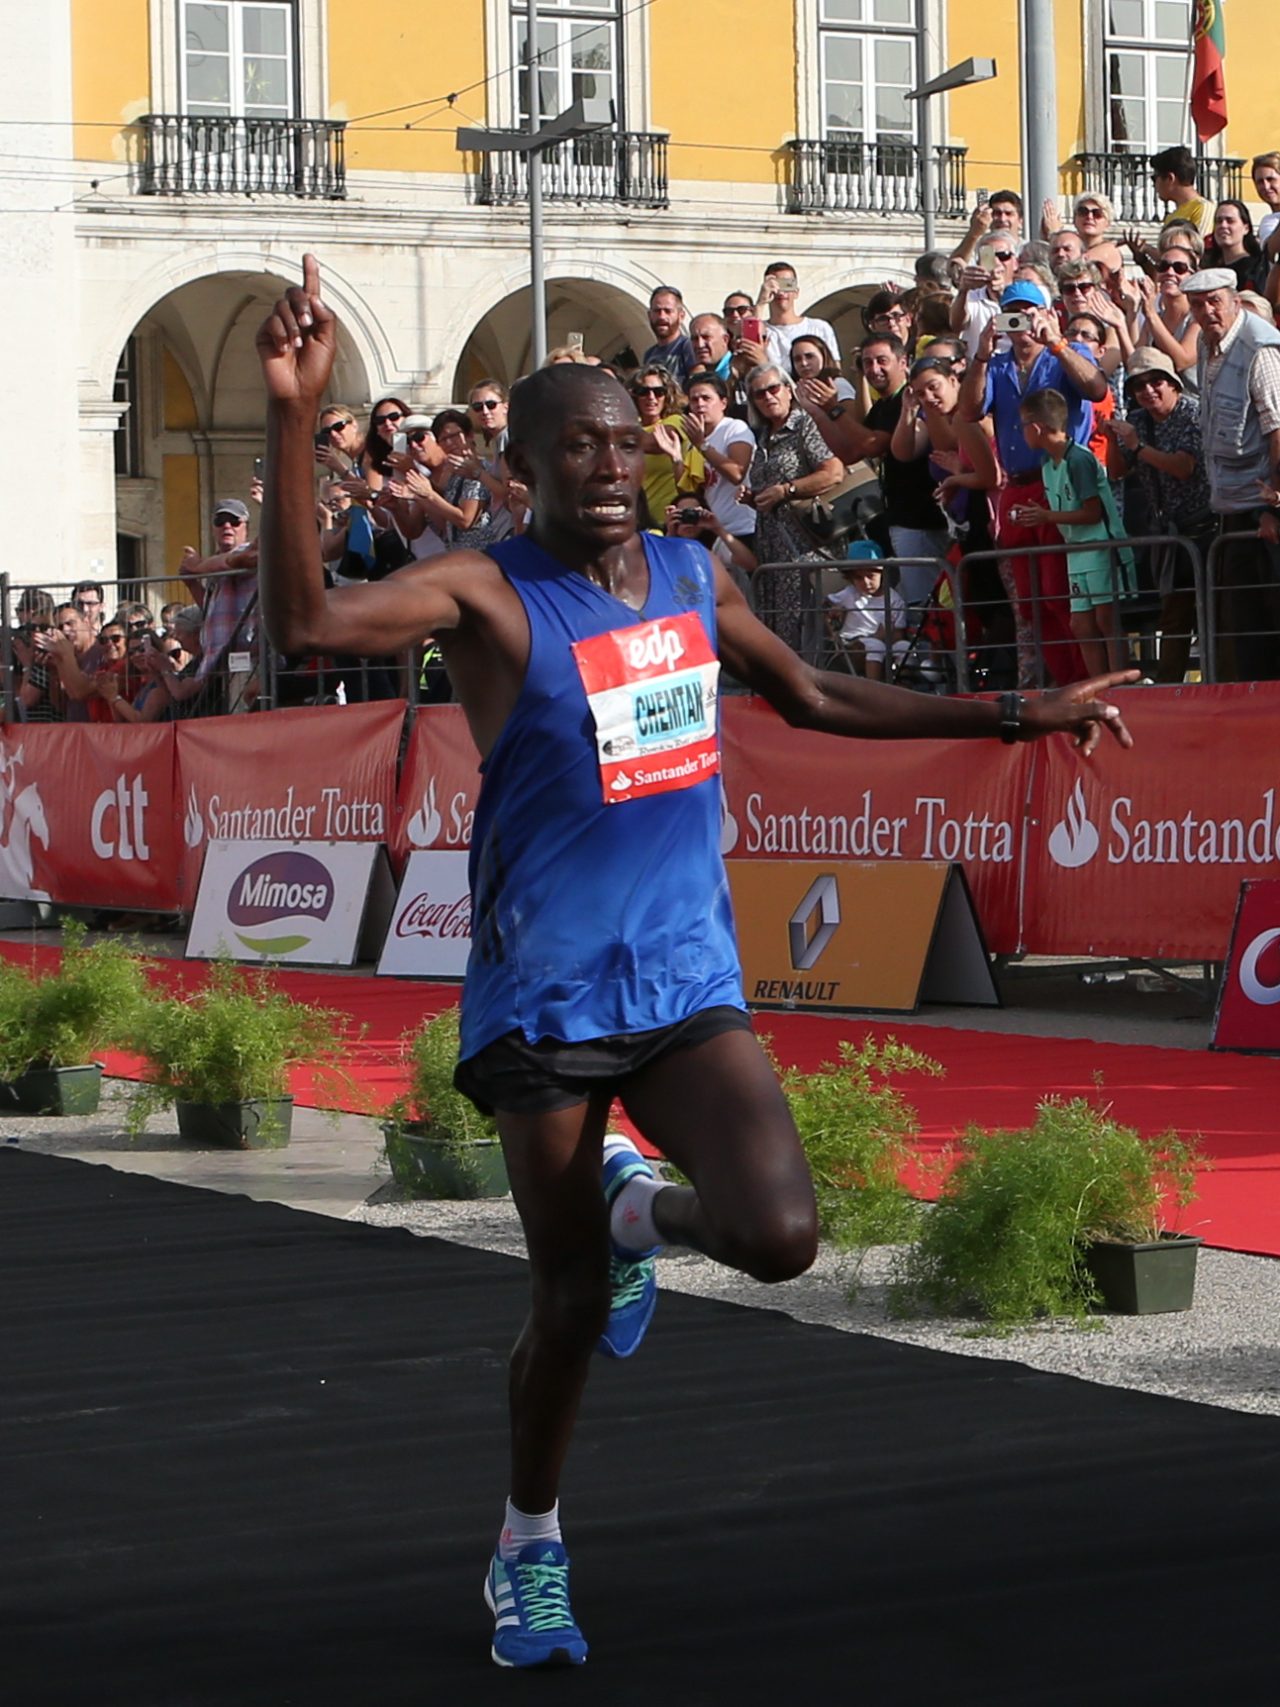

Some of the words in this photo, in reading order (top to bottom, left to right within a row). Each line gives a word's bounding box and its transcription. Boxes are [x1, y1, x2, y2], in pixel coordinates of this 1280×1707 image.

[629, 624, 685, 671] edp
[634, 757, 699, 787] Santander
[91, 774, 148, 860] ctt
[207, 786, 316, 840] Santander
[321, 788, 384, 837] Totta
[747, 790, 907, 857] Santander
[915, 797, 1013, 862] Totta
[240, 873, 328, 909] Mimosa
[753, 979, 841, 1001] RENAULT
